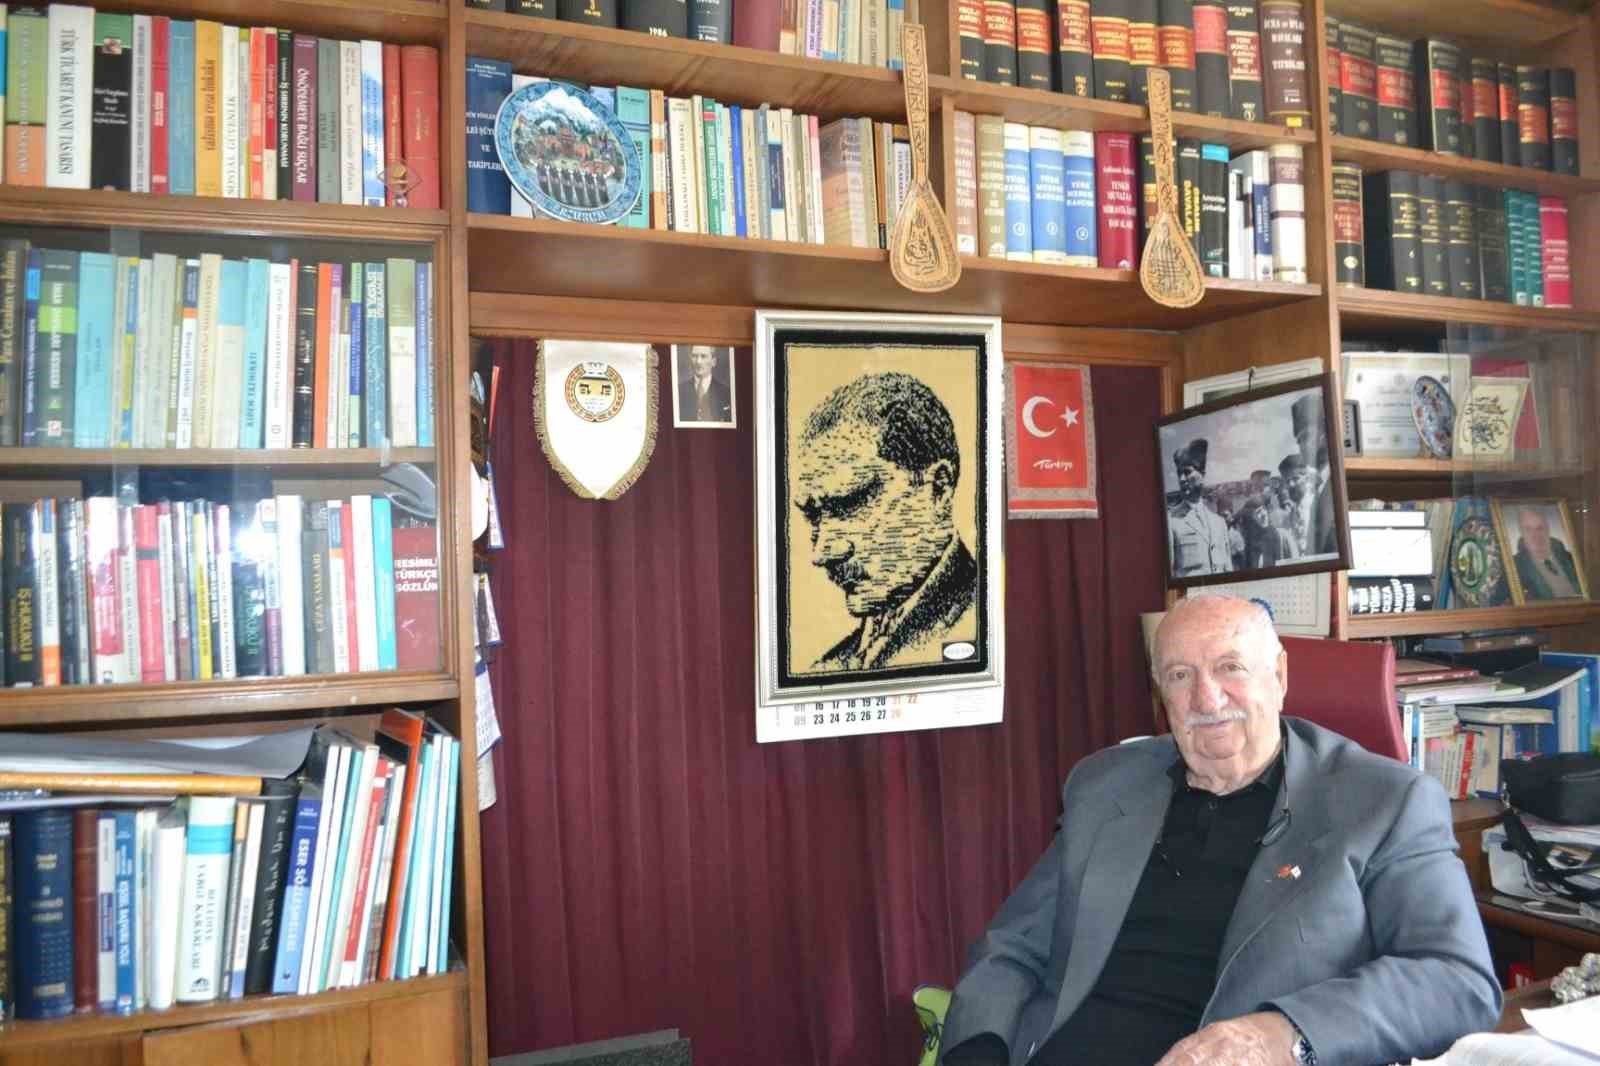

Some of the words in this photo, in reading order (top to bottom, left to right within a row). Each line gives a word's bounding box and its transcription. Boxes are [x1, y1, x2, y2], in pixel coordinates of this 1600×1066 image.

[814, 714, 824, 725] 23
[830, 713, 840, 724] 24
[845, 711, 856, 722] 25
[861, 710, 871, 721] 26
[877, 709, 886, 720] 27
